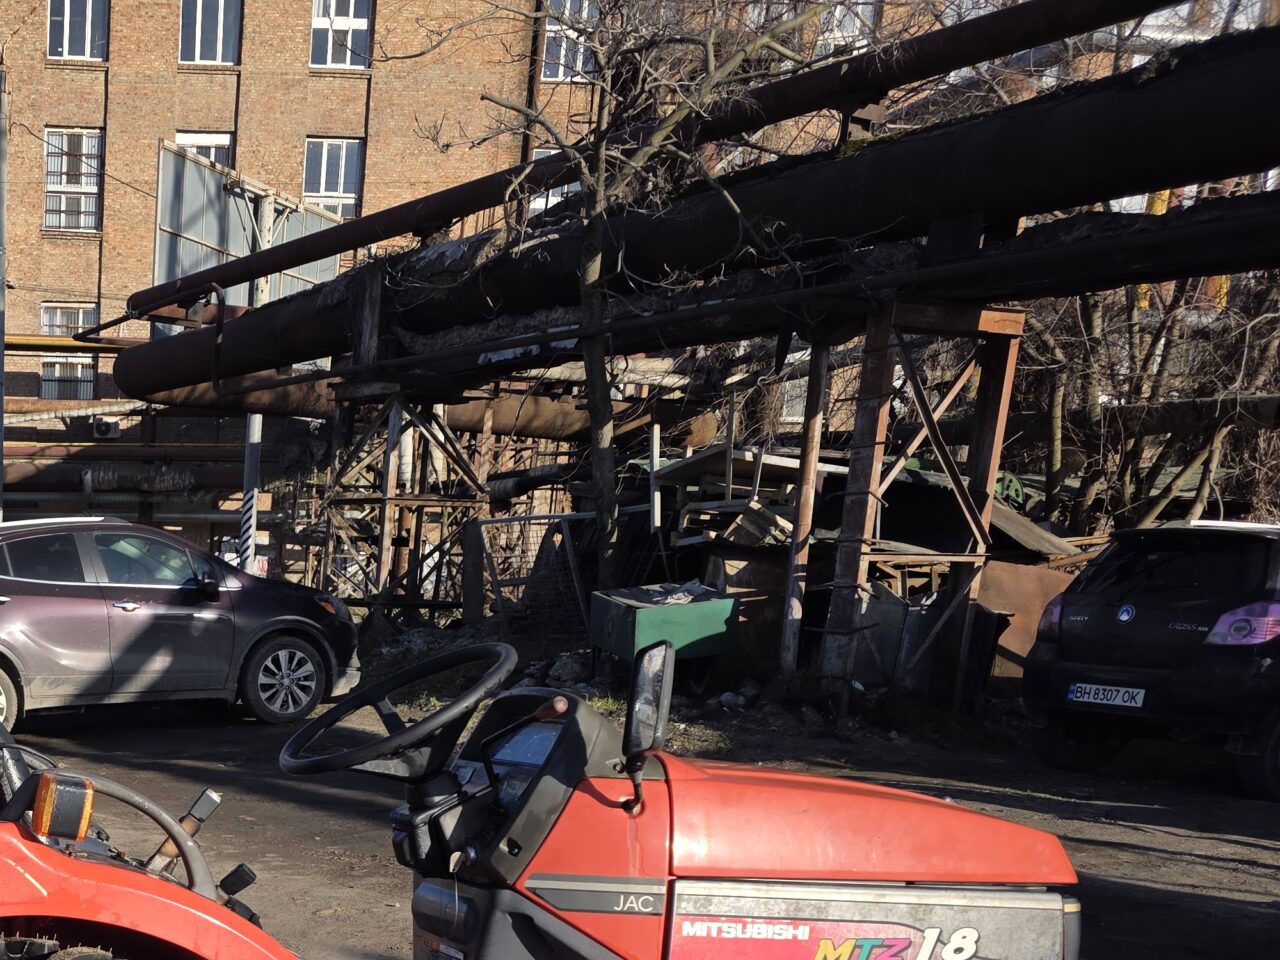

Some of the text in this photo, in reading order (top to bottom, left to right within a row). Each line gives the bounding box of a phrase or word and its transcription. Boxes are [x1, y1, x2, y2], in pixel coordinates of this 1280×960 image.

[1074, 685, 1141, 705] BH 8307 OK
[614, 894, 654, 912] JAC
[682, 920, 811, 941] MITSUBISHI
